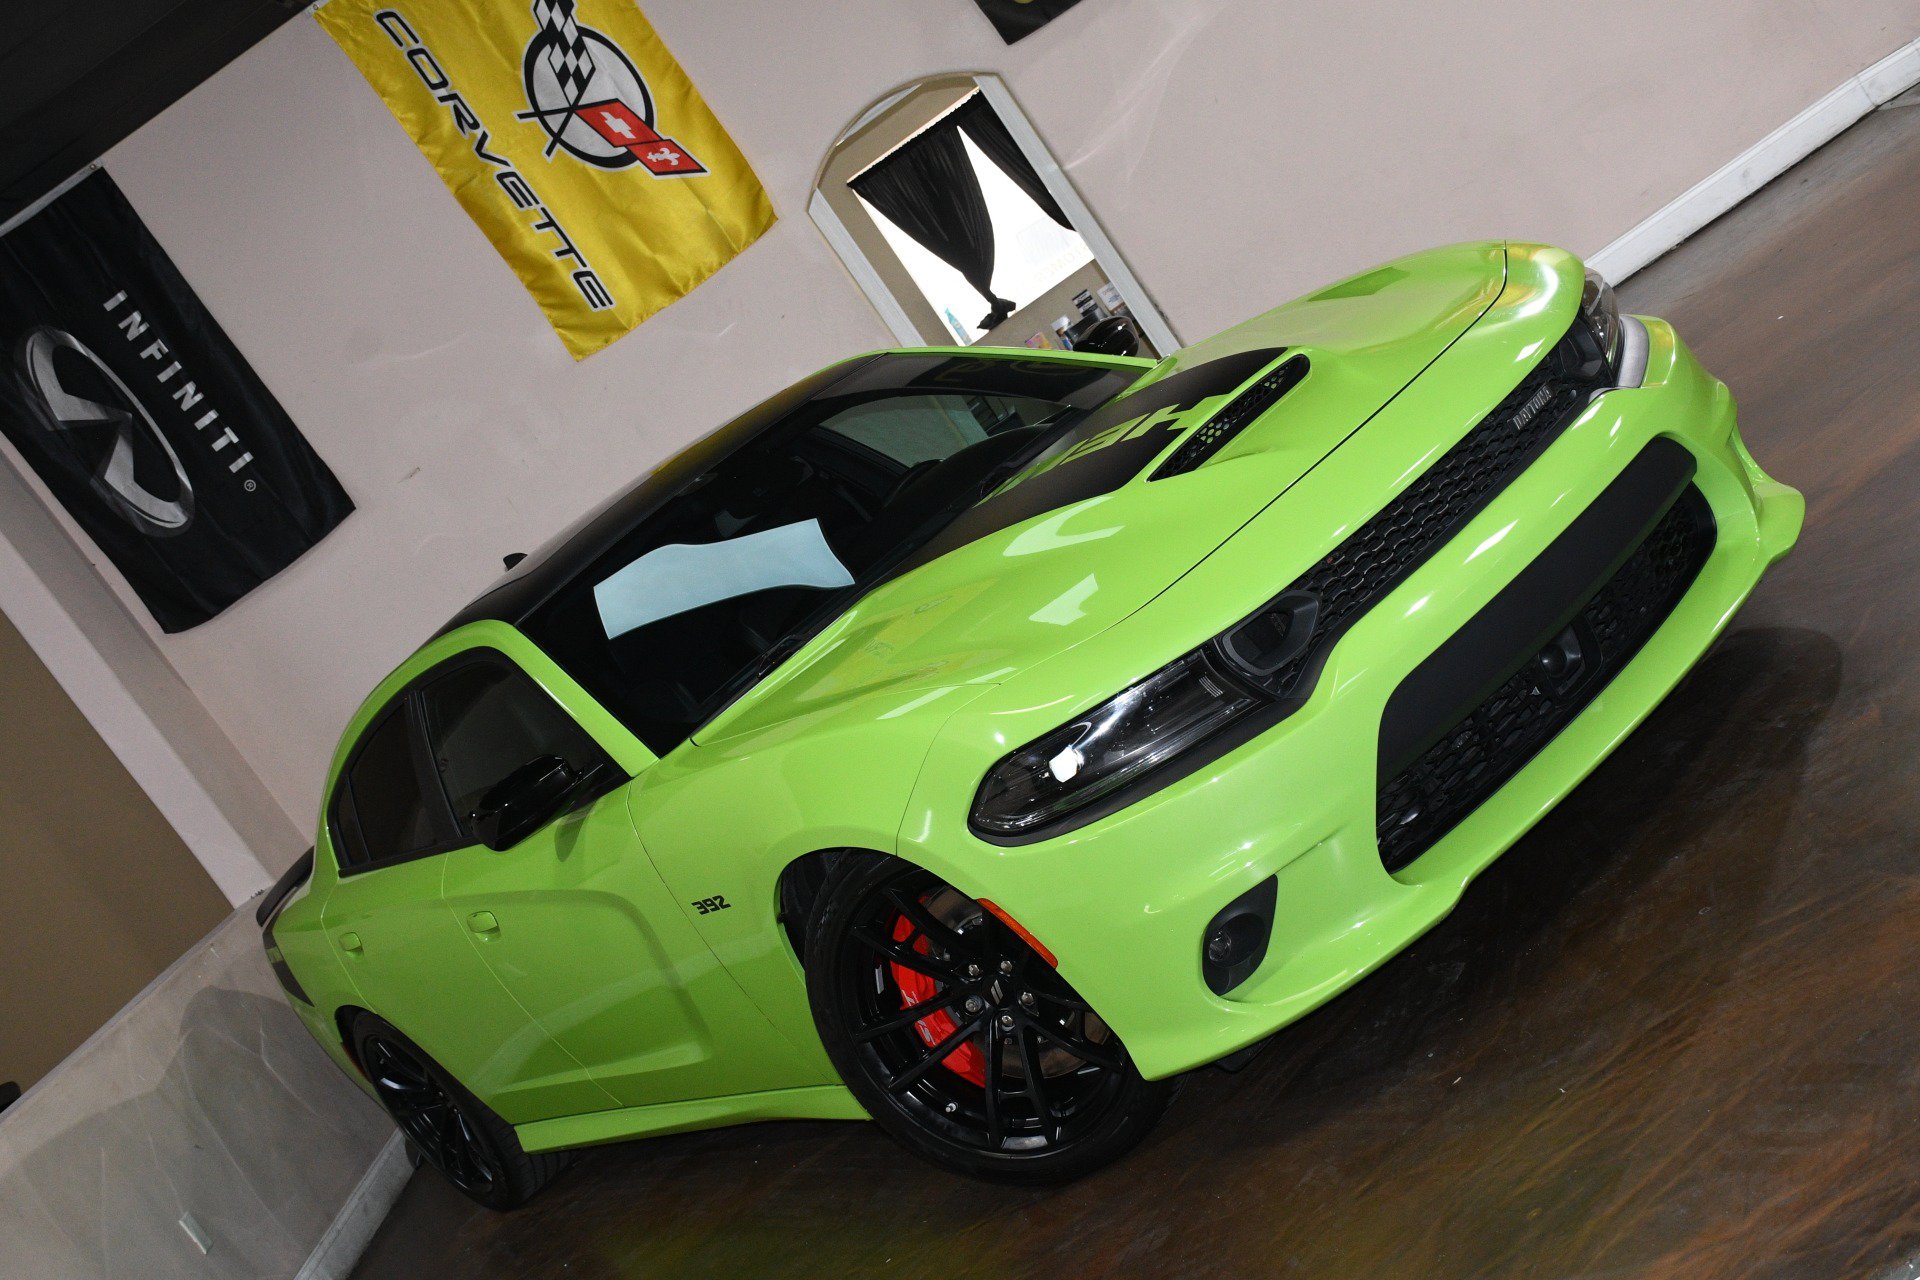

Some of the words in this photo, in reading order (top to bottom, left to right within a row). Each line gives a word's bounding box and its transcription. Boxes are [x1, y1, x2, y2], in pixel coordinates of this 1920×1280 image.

[375, 11, 614, 309] CORVETTE
[103, 290, 254, 473] INFINITI
[691, 895, 731, 915] 392
